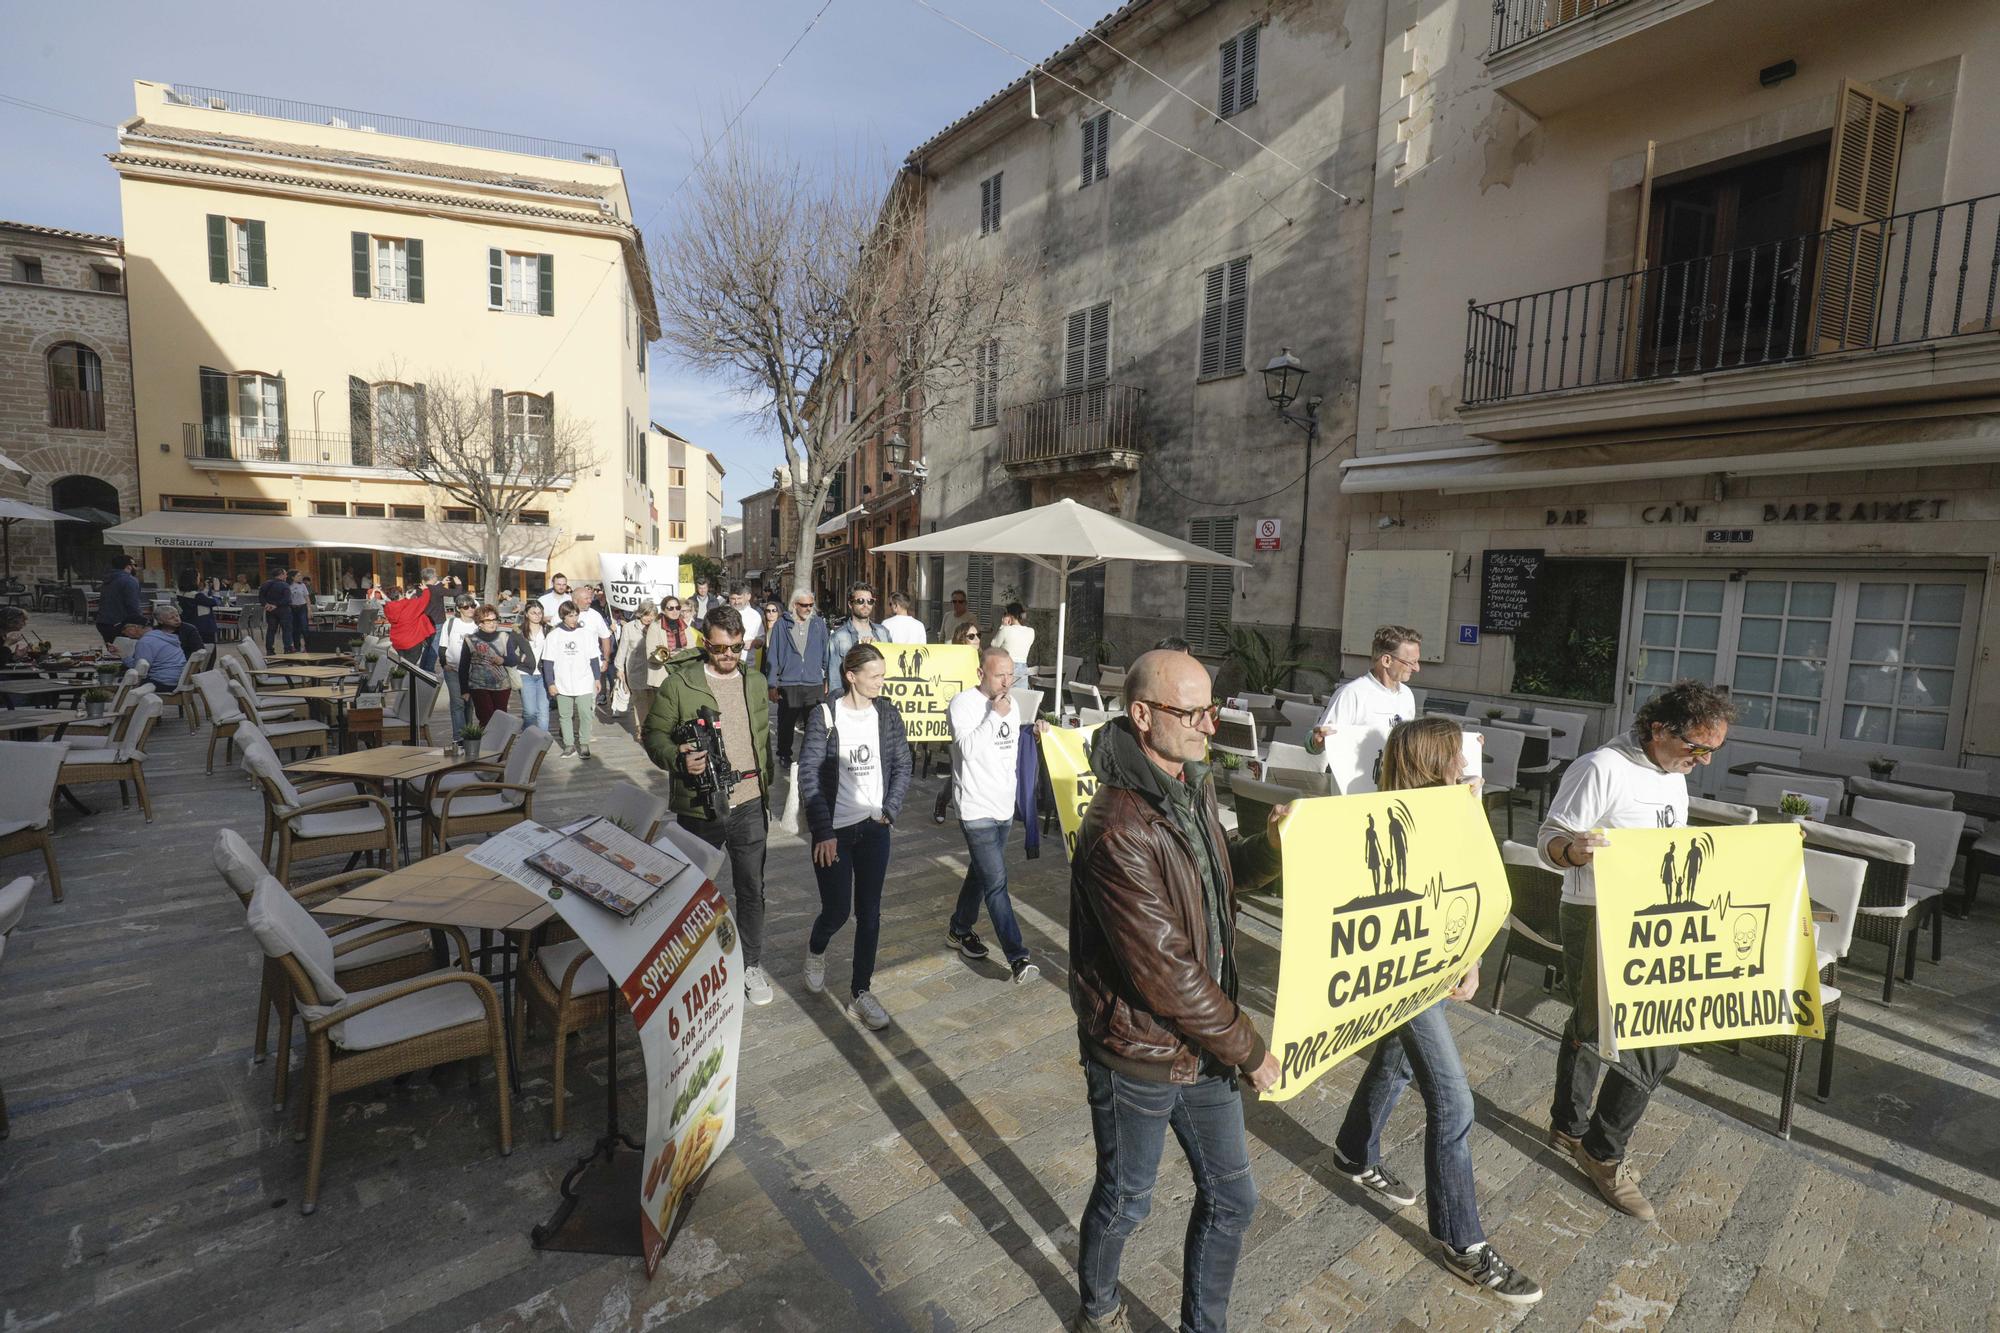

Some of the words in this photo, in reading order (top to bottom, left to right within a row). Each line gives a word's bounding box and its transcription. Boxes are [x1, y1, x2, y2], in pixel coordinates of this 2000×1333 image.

[1546, 509, 1587, 525] BAR
[1762, 500, 1945, 523] BARRAIXET
[154, 536, 214, 547] Restaurant
[1712, 531, 1721, 541] 2
[611, 584, 629, 594] NO
[634, 585, 650, 595] AL
[1464, 629, 1473, 638] R
[881, 683, 907, 696] NO
[913, 683, 934, 697] AL
[893, 700, 938, 713] ABLE
[850, 744, 870, 764] NO
[1656, 804, 1675, 828] NO
[1330, 914, 1381, 958] NO
[1390, 905, 1429, 944] AL
[1628, 918, 1673, 949] NO
[1680, 915, 1716, 944] AL
[641, 934, 689, 999] SPECIAL
[682, 899, 715, 944] OFFER
[1328, 948, 1434, 1008] CABLE
[1623, 952, 1723, 987] CABLE
[668, 1006, 680, 1041] 6
[682, 956, 728, 1024] TAPAS
[1630, 997, 1697, 1038] ZONAS
[1700, 988, 1815, 1031] POBLADAS
[681, 1030, 696, 1052] FOR
[698, 1019, 703, 1035] 2
[704, 1003, 723, 1027] PERS.
[708, 1021, 719, 1040] and
[1280, 1030, 1328, 1089] POR
[1319, 1003, 1392, 1063] ZONAS
